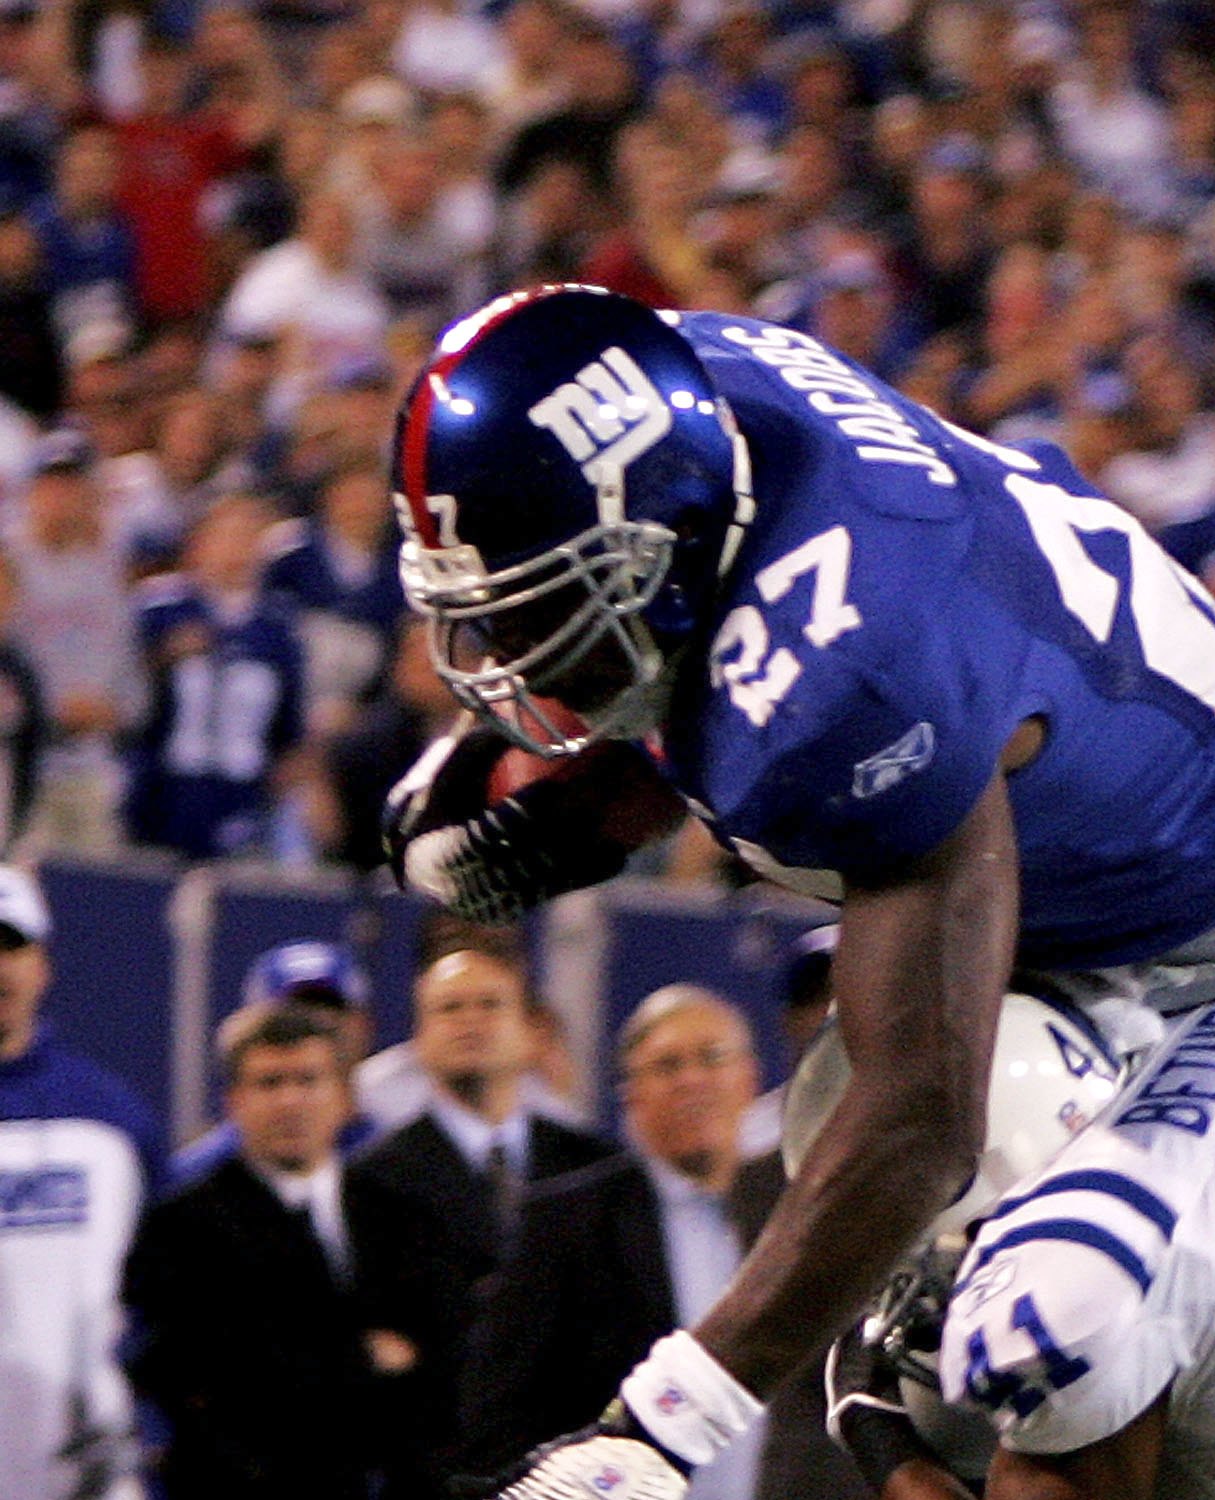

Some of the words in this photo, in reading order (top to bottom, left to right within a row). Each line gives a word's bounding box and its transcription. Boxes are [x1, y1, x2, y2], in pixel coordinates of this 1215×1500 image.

[722, 326, 957, 485] JACOBS
[710, 525, 863, 727] 27
[967, 1292, 1091, 1418] 41
